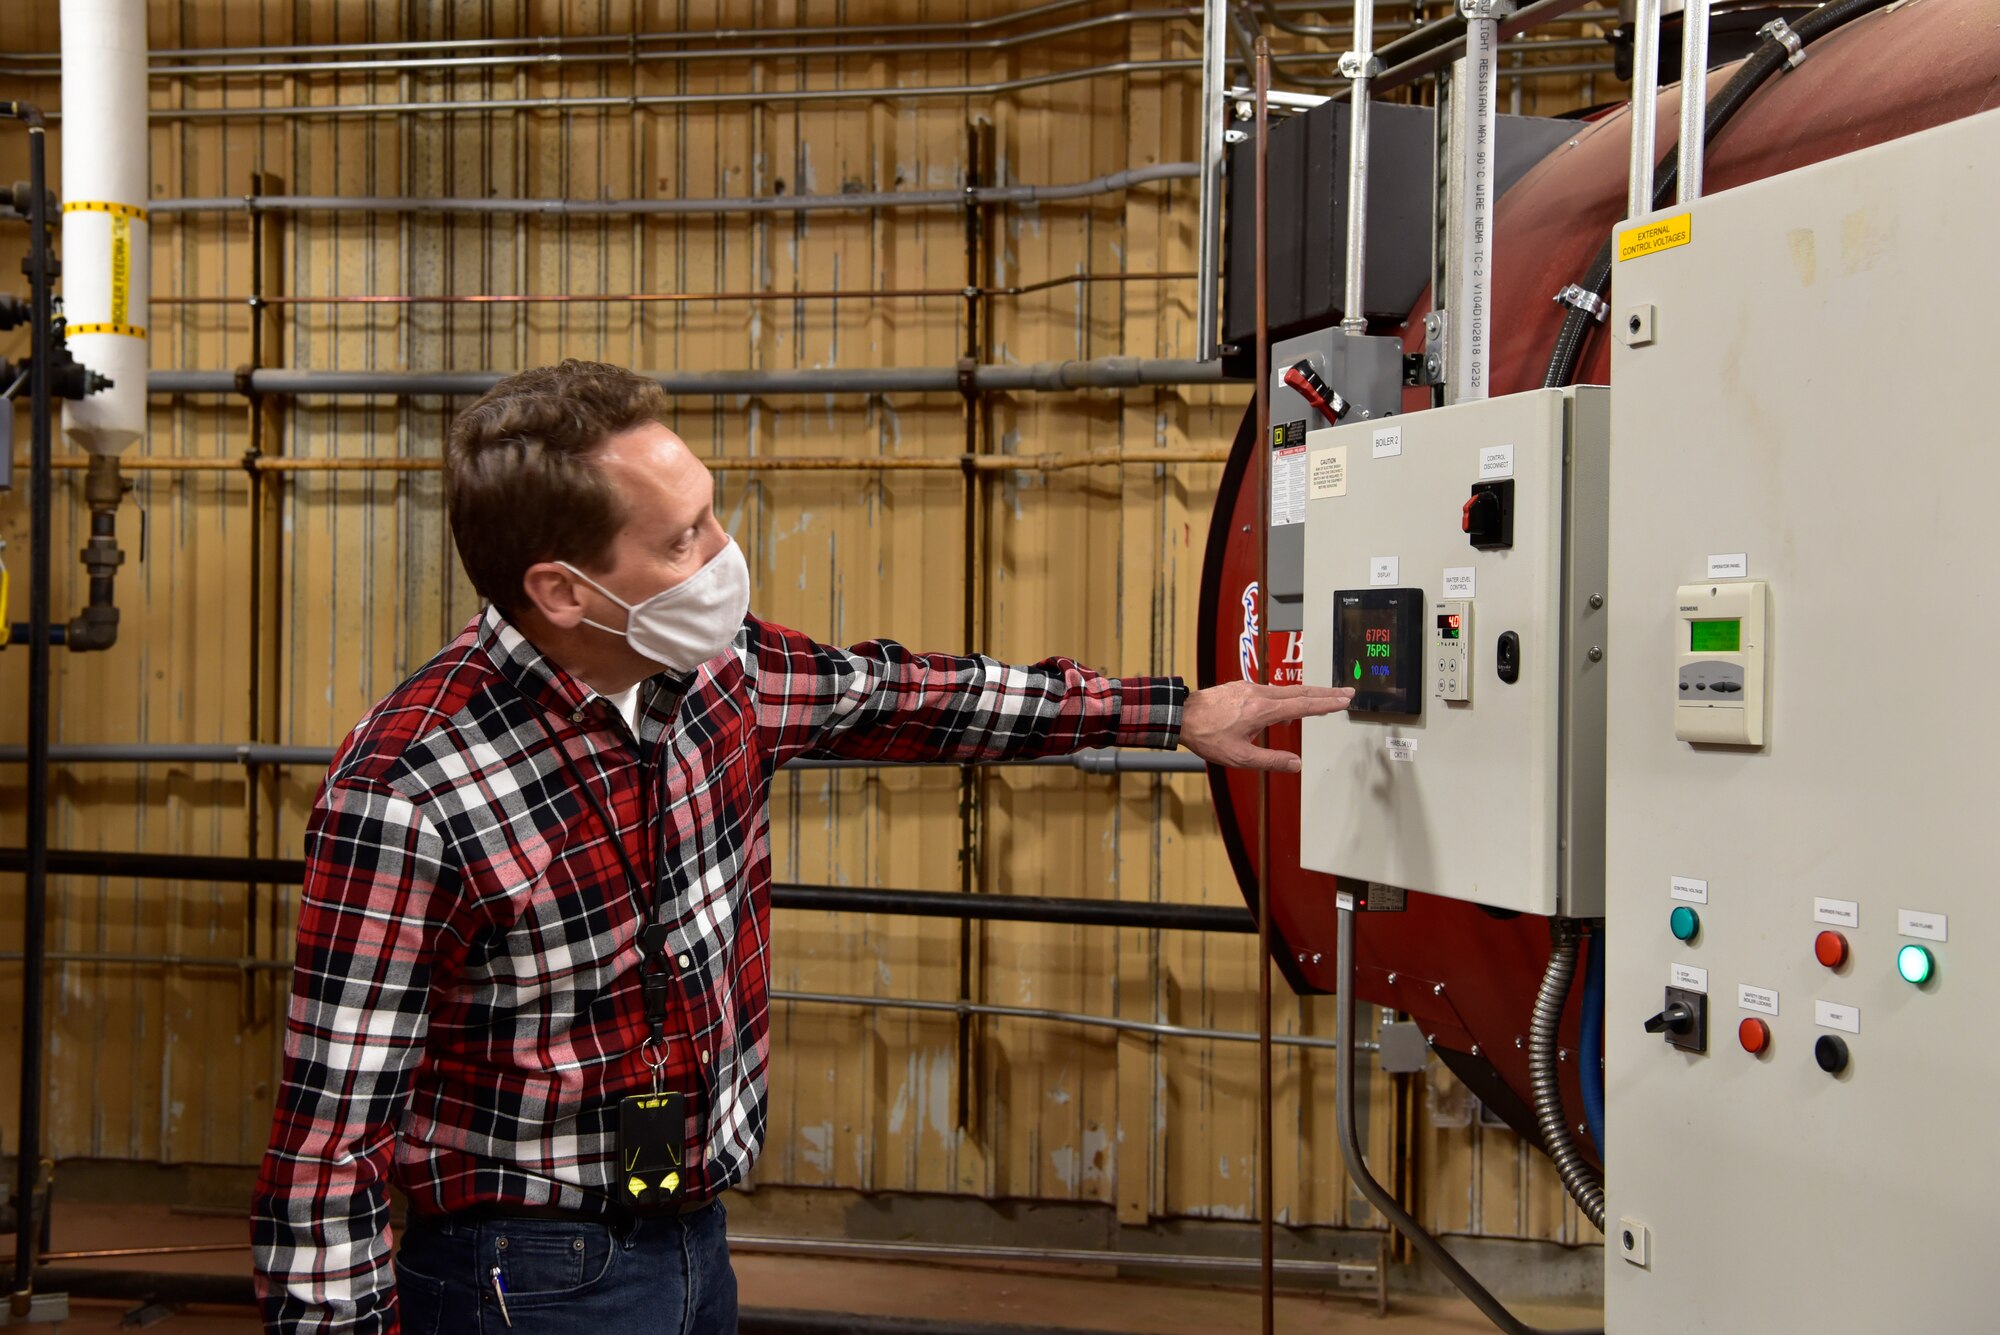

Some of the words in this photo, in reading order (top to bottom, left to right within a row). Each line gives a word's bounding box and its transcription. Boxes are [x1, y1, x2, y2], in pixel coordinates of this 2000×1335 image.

[1478, 58, 1488, 118] RESISTANT
[1477, 124, 1487, 145] MAX
[1476, 184, 1485, 210] WIRE
[1474, 216, 1484, 244] NEMA
[1637, 225, 1670, 241] EXTERNAL
[1622, 242, 1652, 256] CONTROL
[1653, 231, 1686, 248] VOLTAGES
[1474, 250, 1484, 276] TC-2
[1471, 362, 1481, 388] 0232
[1376, 436, 1394, 448] BOILER
[1395, 436, 1398, 444] 2
[1320, 458, 1336, 466] CAUTION
[1484, 462, 1508, 470] DISCONNECT
[1366, 629, 1390, 642] 67PSI
[1366, 644, 1390, 657] 75PSI
